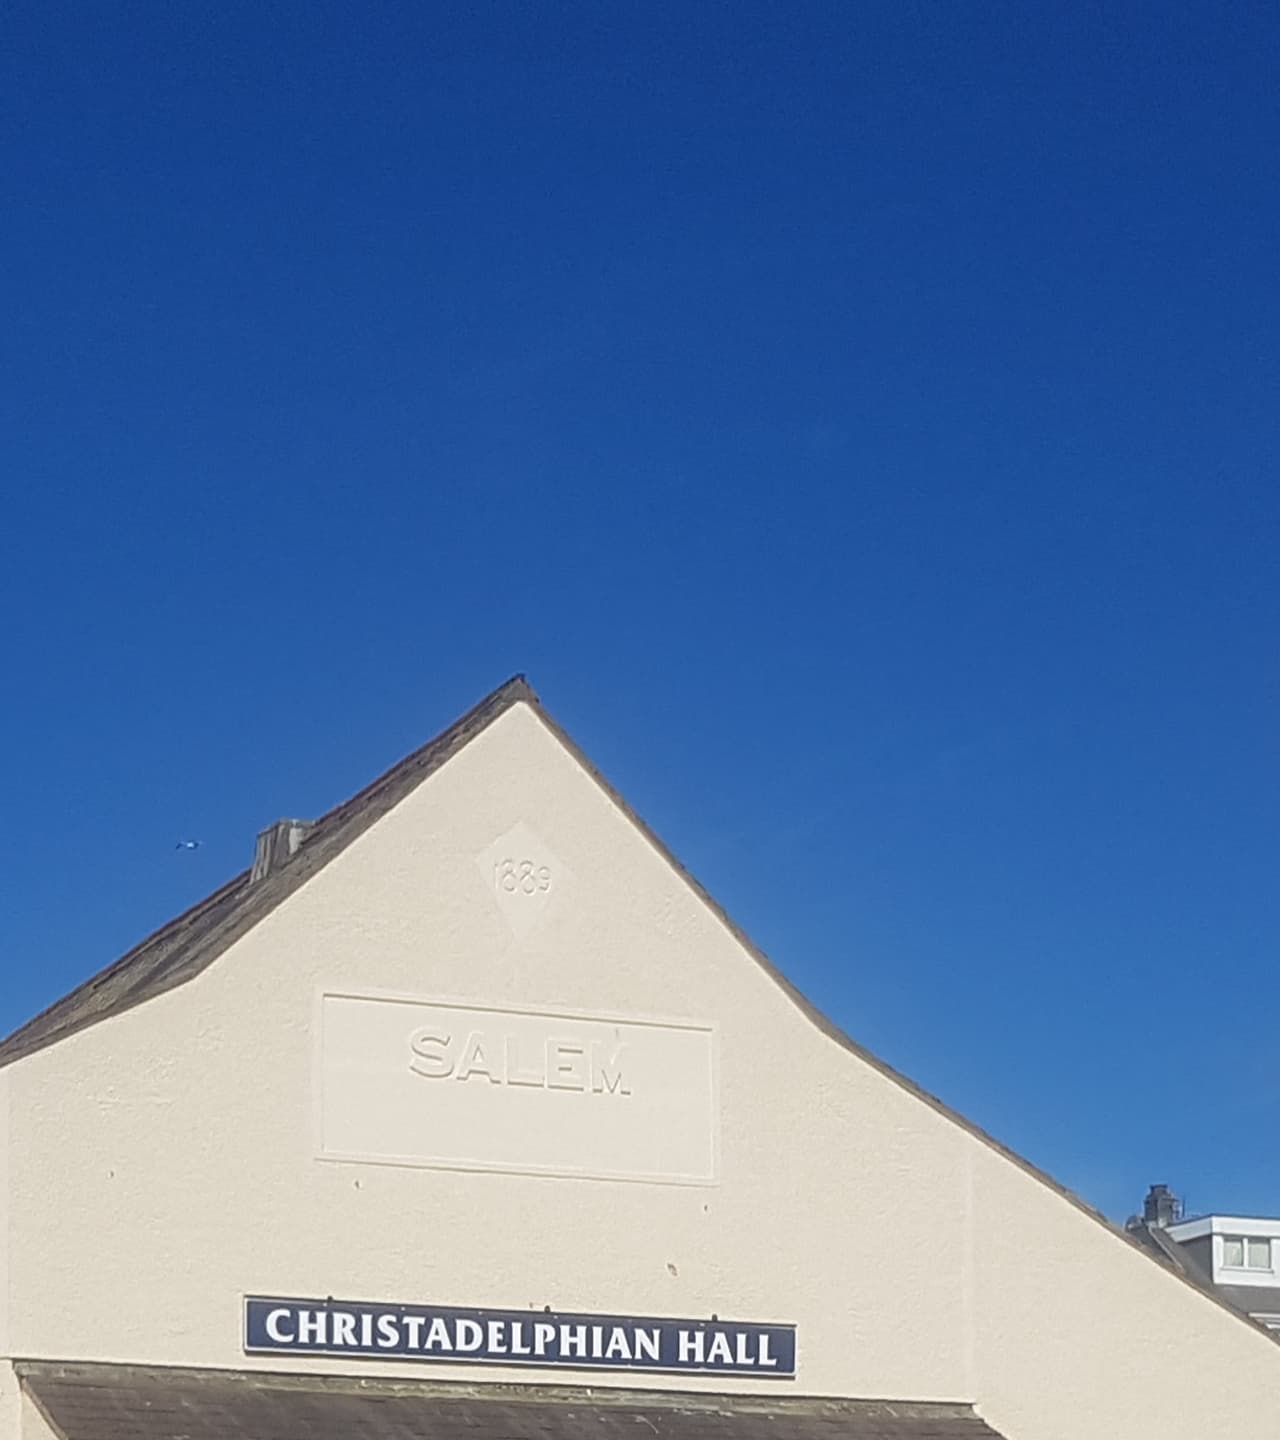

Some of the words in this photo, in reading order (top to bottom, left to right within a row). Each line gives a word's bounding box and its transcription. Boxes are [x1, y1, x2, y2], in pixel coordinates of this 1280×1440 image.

[494, 859, 552, 896] 1889
[409, 1026, 632, 1096] SALEM
[265, 1308, 661, 1361] CHRISTADELPHIAN
[677, 1330, 777, 1367] HALL
